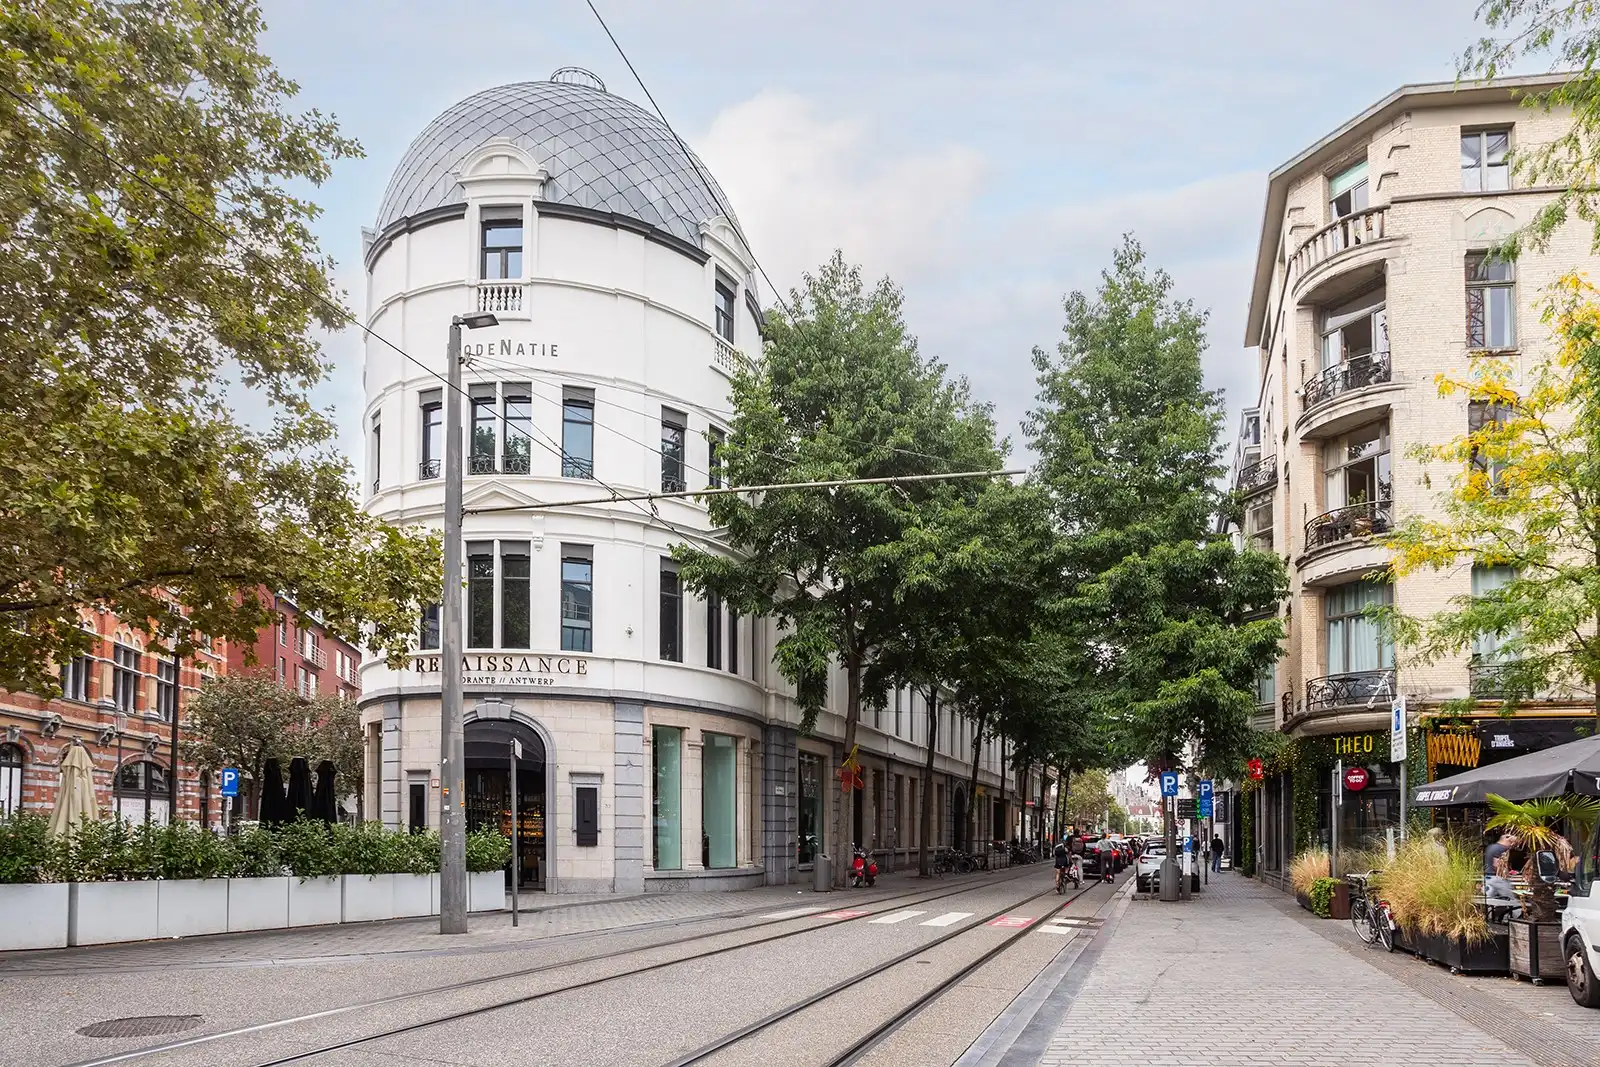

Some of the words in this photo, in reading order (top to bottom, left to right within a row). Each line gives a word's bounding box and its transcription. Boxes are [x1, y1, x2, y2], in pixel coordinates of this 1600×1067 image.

[446, 339, 558, 357] ODENATIE
[415, 656, 587, 675] REAISSANCE
[509, 676, 554, 686] ANTWERP
[1333, 735, 1373, 754] THEO
[224, 771, 236, 786] P
[1163, 776, 1176, 793] P
[1201, 783, 1211, 796] P
[1183, 837, 1190, 846] P
